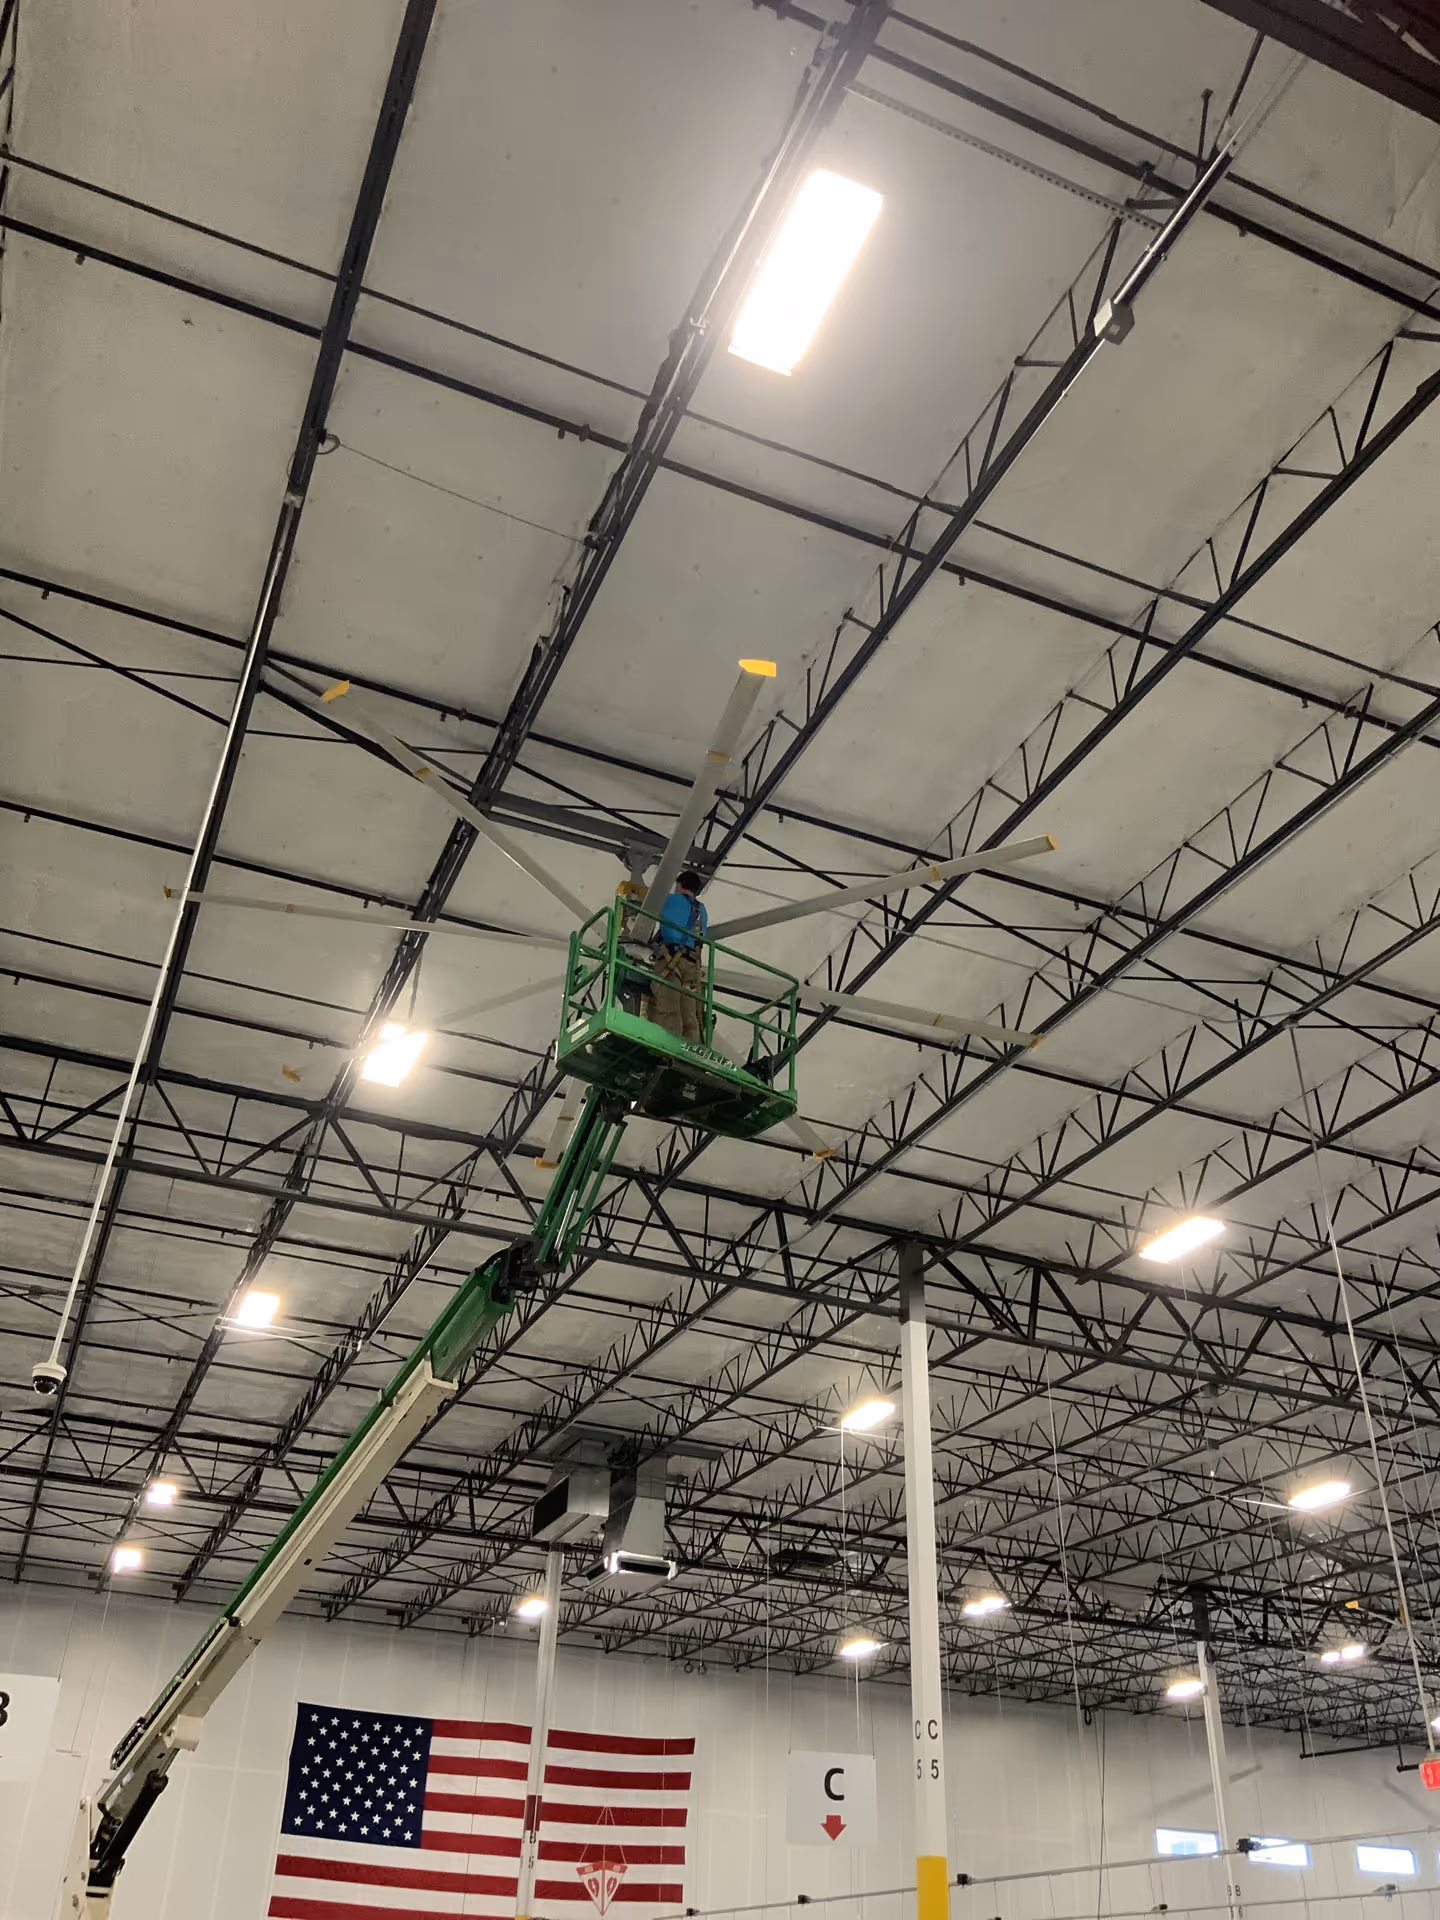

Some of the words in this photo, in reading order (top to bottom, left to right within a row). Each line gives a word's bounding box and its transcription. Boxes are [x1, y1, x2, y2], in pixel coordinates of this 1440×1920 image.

[928, 1719, 938, 1740] C
[931, 1759, 939, 1780] 5
[824, 1767, 845, 1801] C
[1235, 1884, 1241, 1896] B
